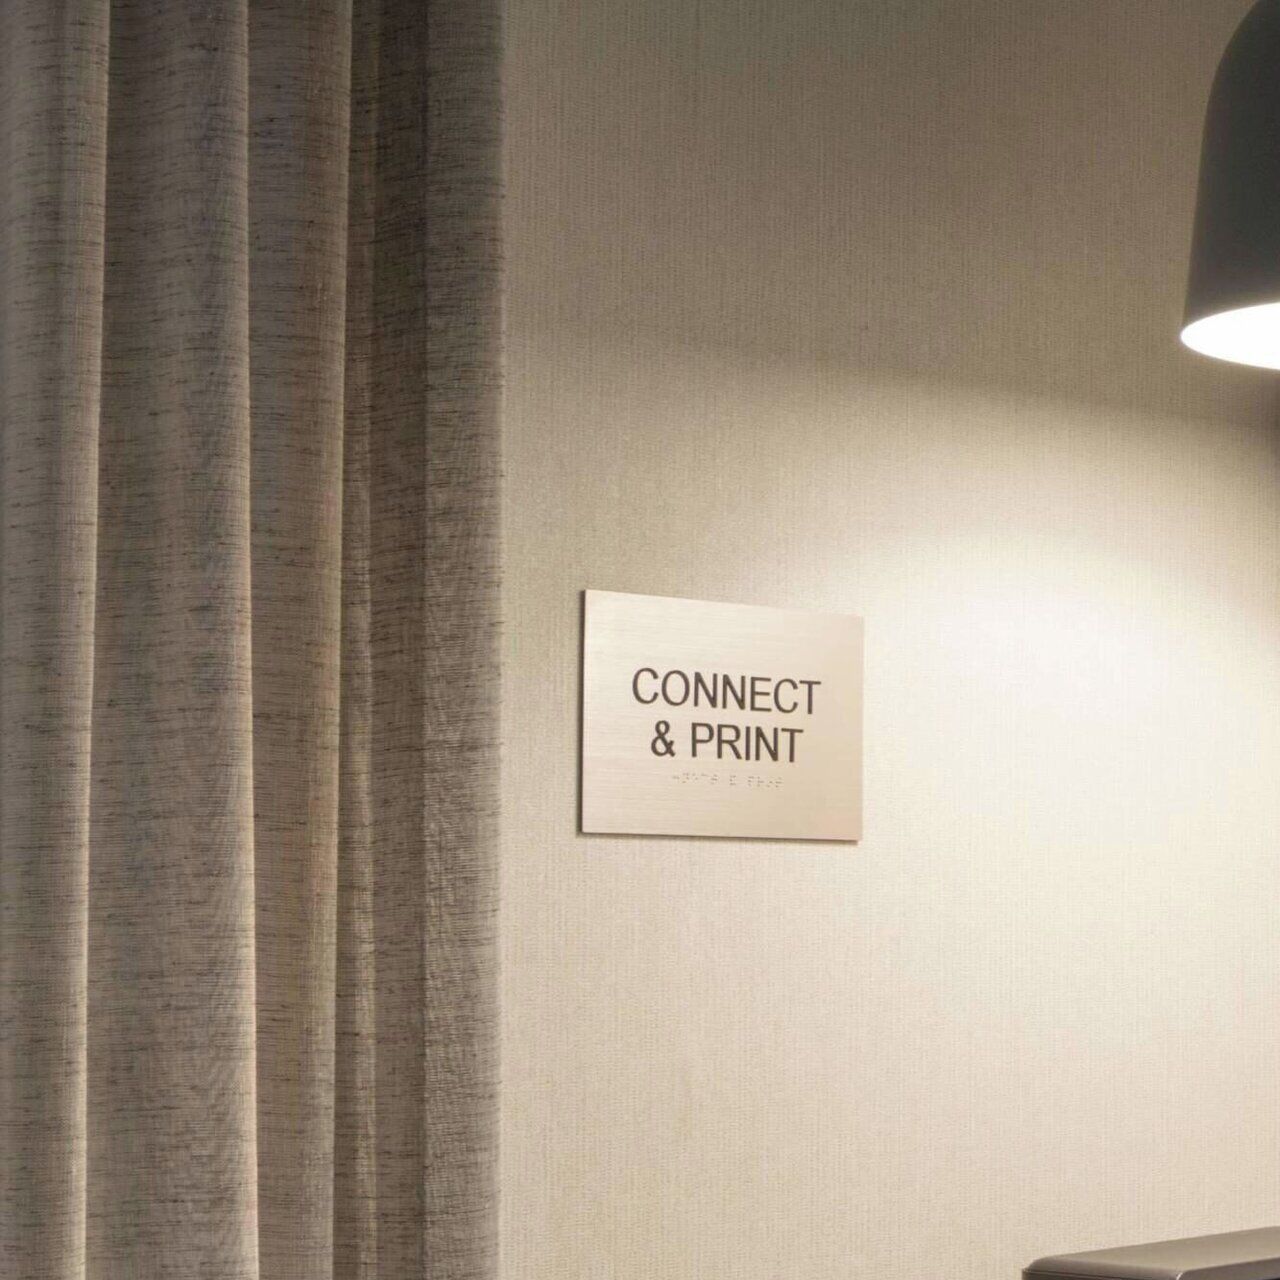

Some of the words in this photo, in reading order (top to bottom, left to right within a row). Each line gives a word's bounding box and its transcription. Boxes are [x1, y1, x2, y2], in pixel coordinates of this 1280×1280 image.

[632, 667, 821, 715] CONNECT
[650, 719, 676, 757] &
[691, 722, 804, 763] PRINT
